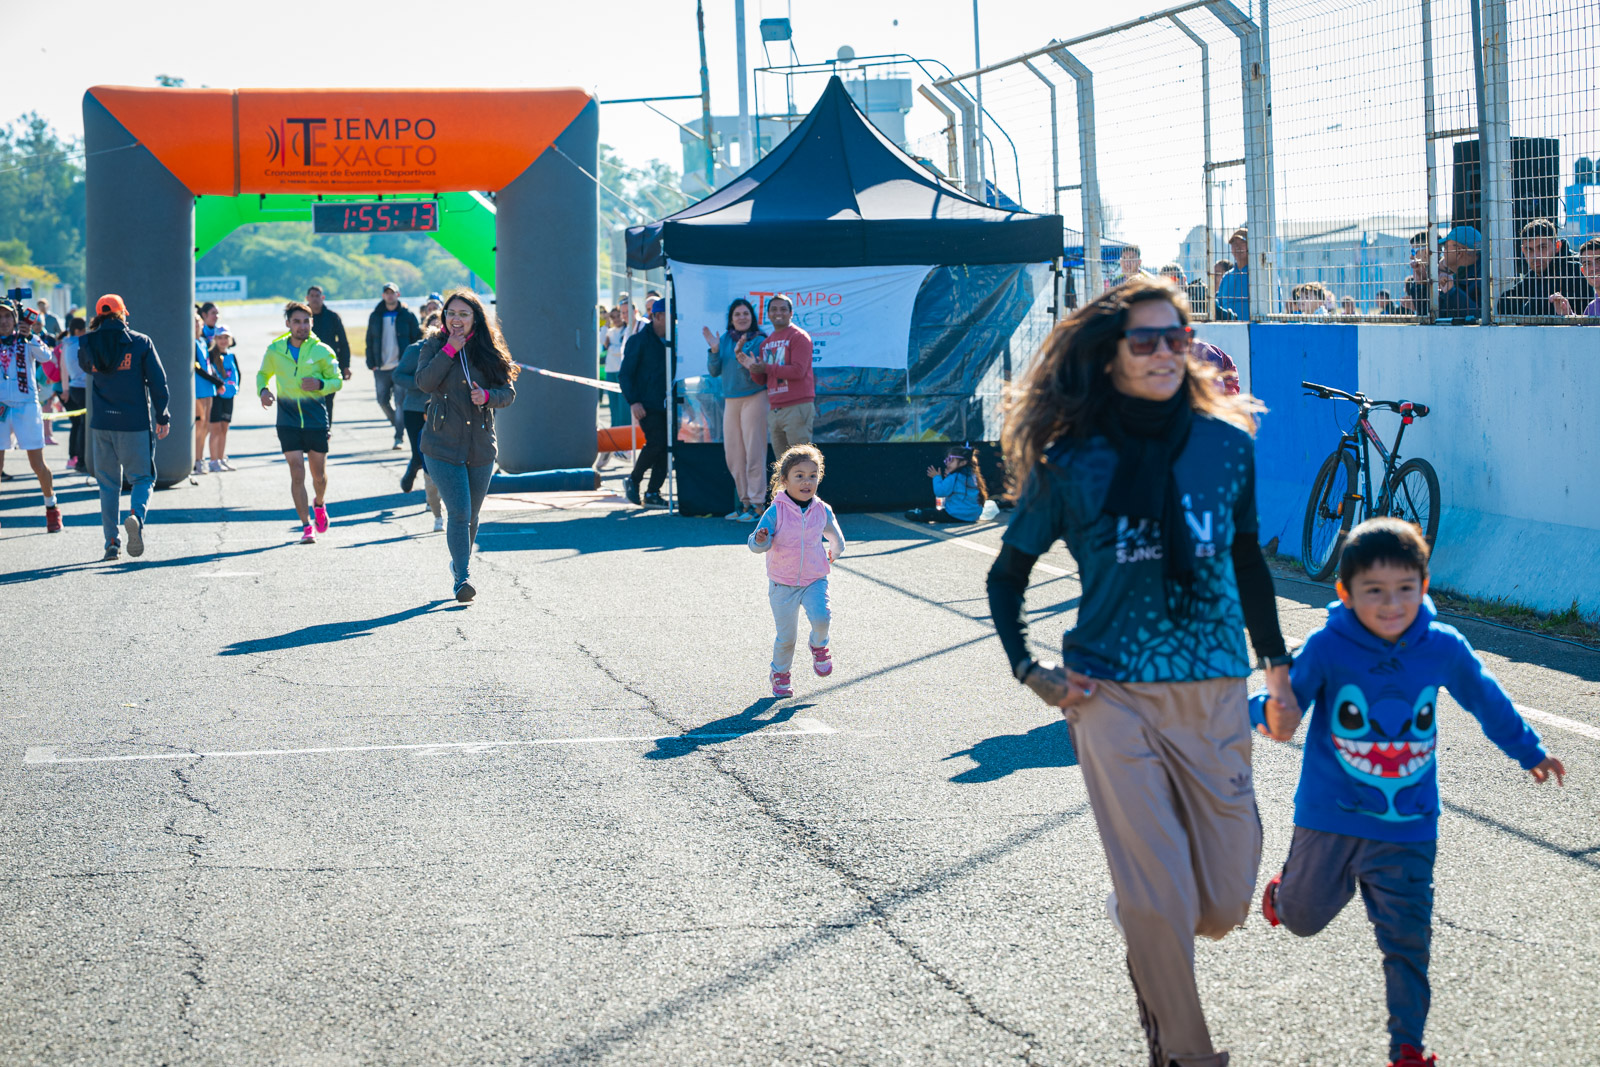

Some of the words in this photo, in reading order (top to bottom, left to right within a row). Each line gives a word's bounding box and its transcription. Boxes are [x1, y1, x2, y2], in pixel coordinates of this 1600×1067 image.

[286, 118, 436, 166] TIEMPO
[312, 125, 437, 167] EXACTO
[264, 169, 328, 178] Cronometraje
[330, 169, 342, 177] de
[345, 169, 381, 177] Eventos
[384, 168, 436, 178] Deportivos
[343, 203, 436, 231] 1:55:13
